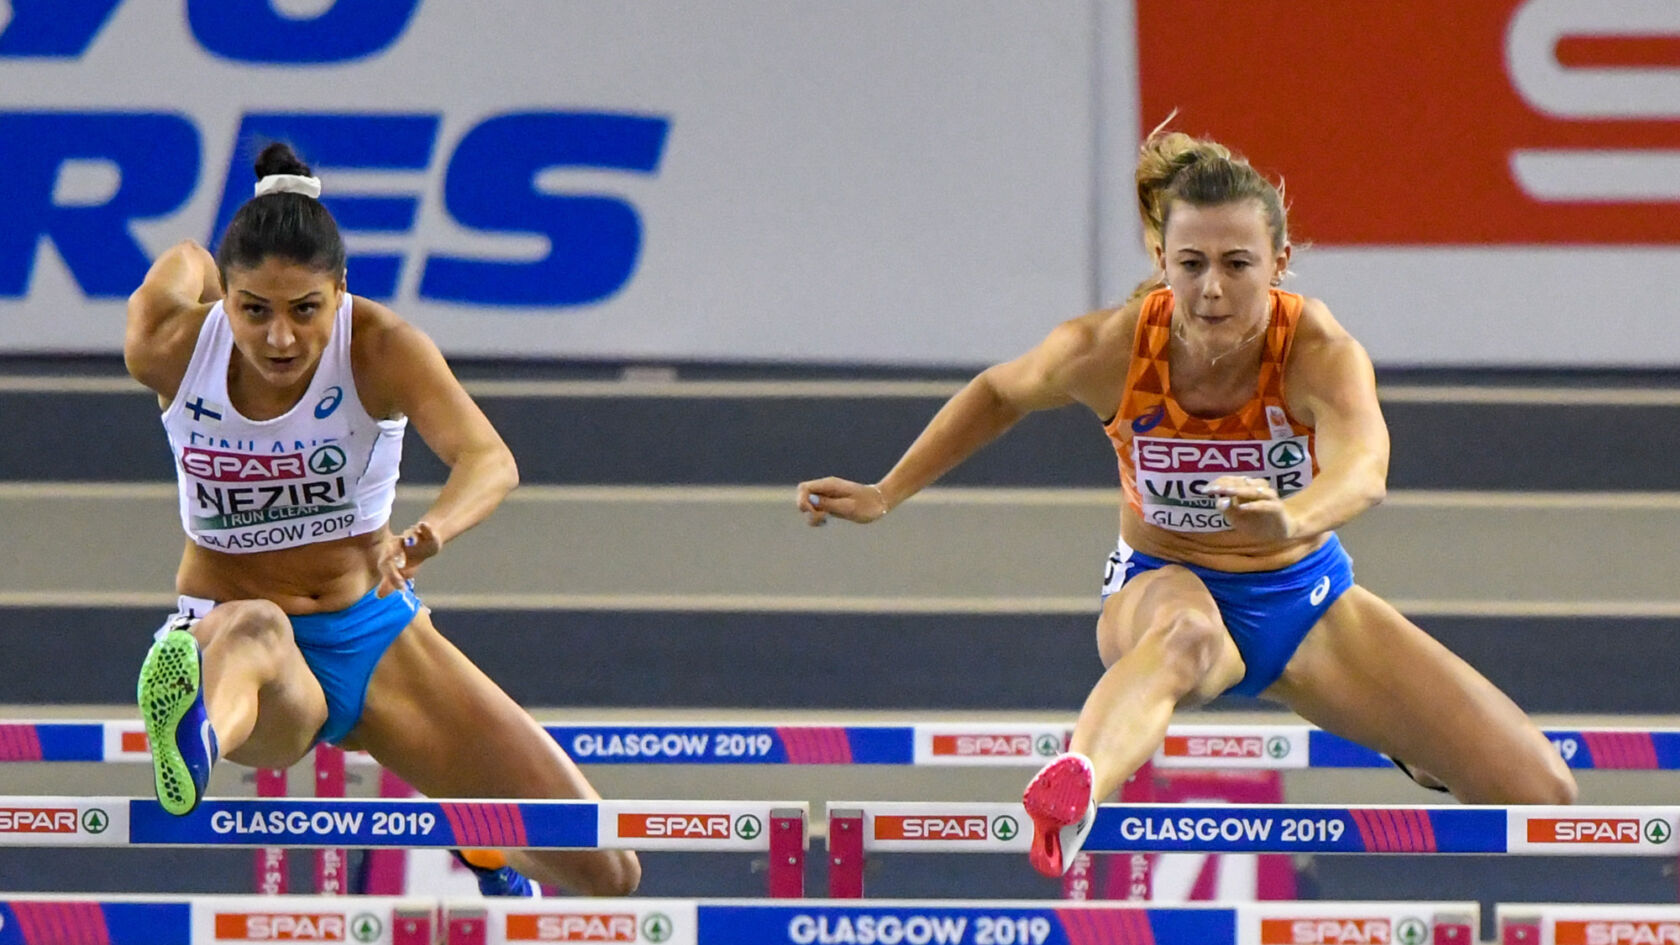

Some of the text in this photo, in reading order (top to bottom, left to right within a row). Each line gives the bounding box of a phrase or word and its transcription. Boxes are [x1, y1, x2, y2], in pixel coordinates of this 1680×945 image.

[184, 452, 303, 478] SPAR
[1143, 444, 1261, 469] SPAR
[196, 476, 346, 514] NEZIRI
[1145, 471, 1304, 498] VISR
[231, 510, 267, 527] RUN
[311, 513, 356, 538] 2019
[573, 734, 773, 758] GLASGOW 2019
[956, 737, 1030, 756] SPAR
[1185, 738, 1261, 757] SPAR
[210, 810, 436, 835] GLASGOW 2019
[645, 816, 728, 837] SPAR
[902, 818, 986, 839] SPAR
[1120, 817, 1345, 842] GLASGOW 2019
[1554, 821, 1639, 841] SPAR
[246, 916, 344, 938] SPAR
[537, 916, 635, 939] SPAR
[789, 915, 1050, 945] GLASGOW 2019
[1292, 920, 1390, 944] SPAR
